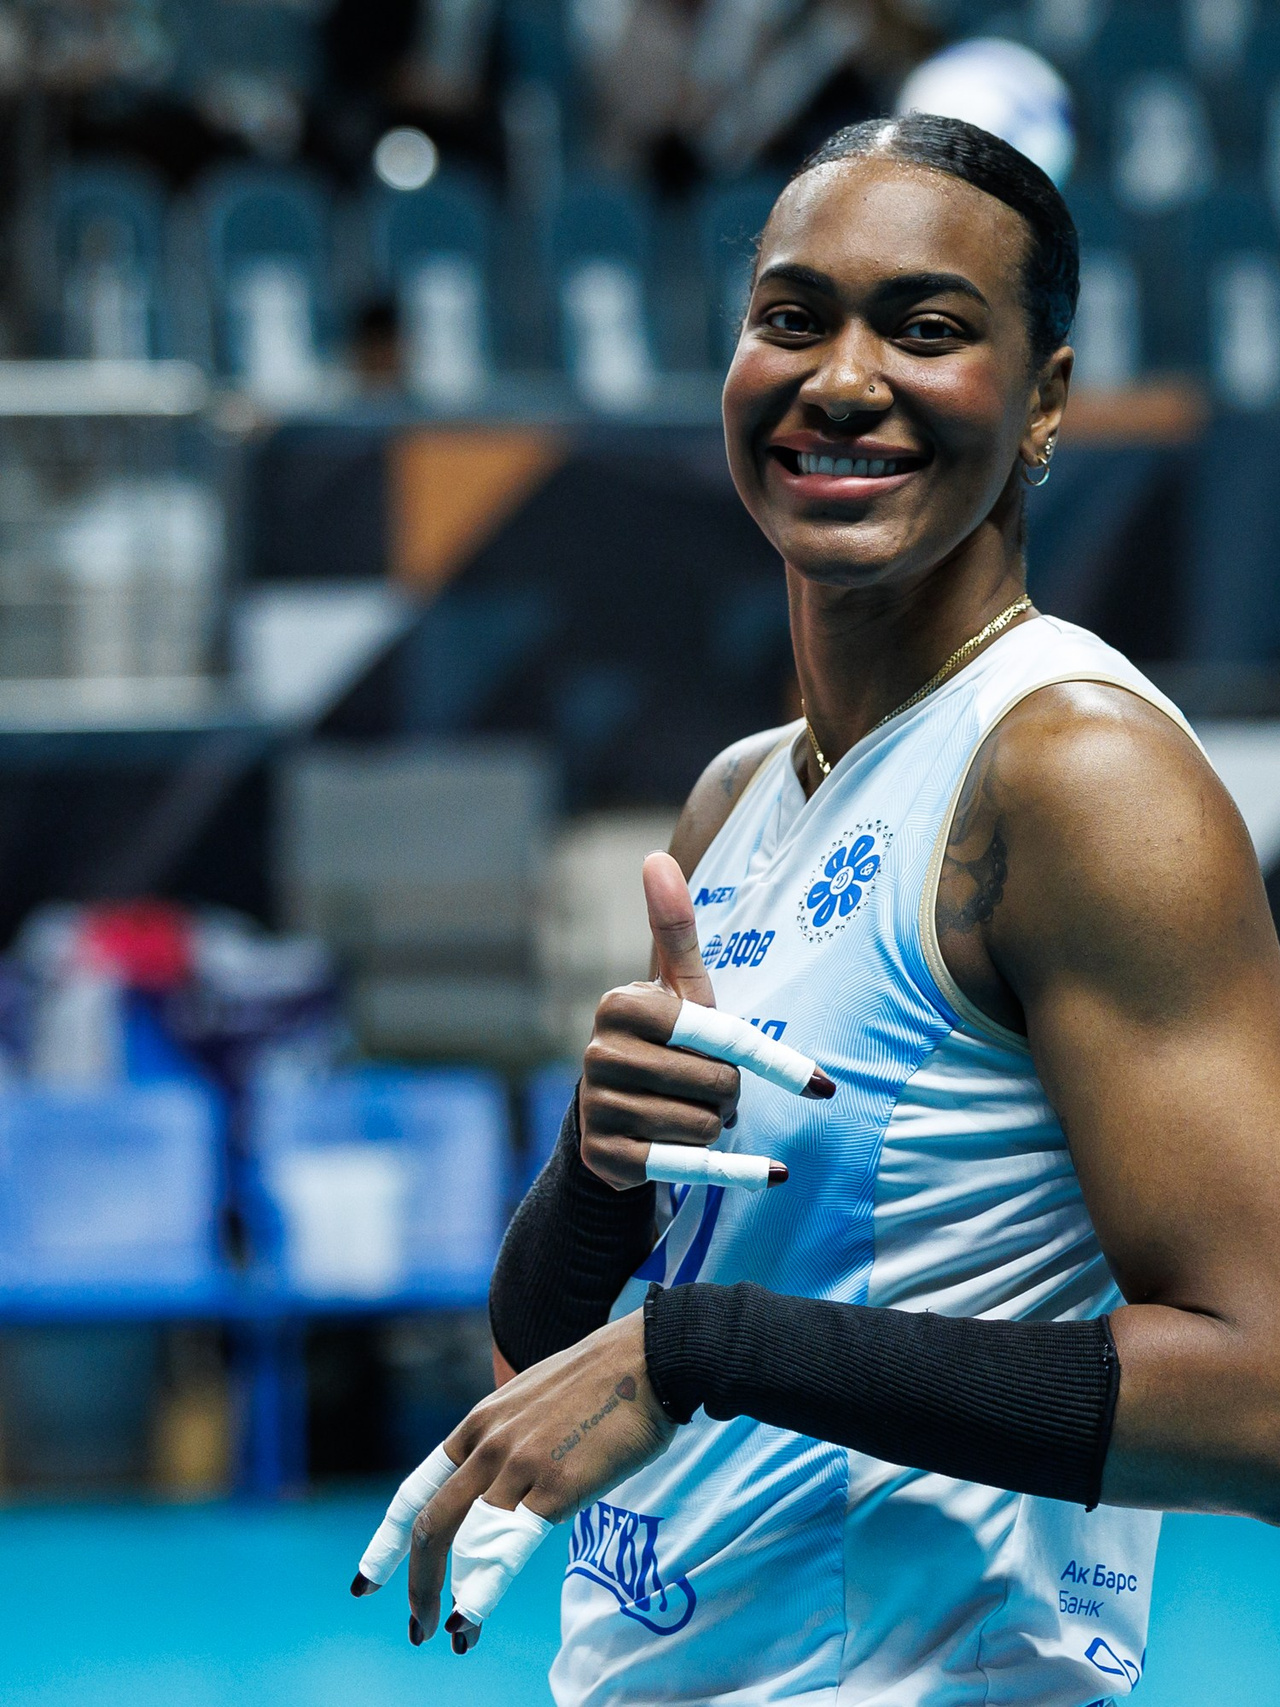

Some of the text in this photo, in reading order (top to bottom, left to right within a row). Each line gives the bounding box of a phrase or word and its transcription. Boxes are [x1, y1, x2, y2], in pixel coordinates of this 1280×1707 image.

[714, 928, 776, 970] ВФВ
[1060, 1559, 1138, 1595] Ак Барс
[1058, 1590, 1105, 1618] Банк
